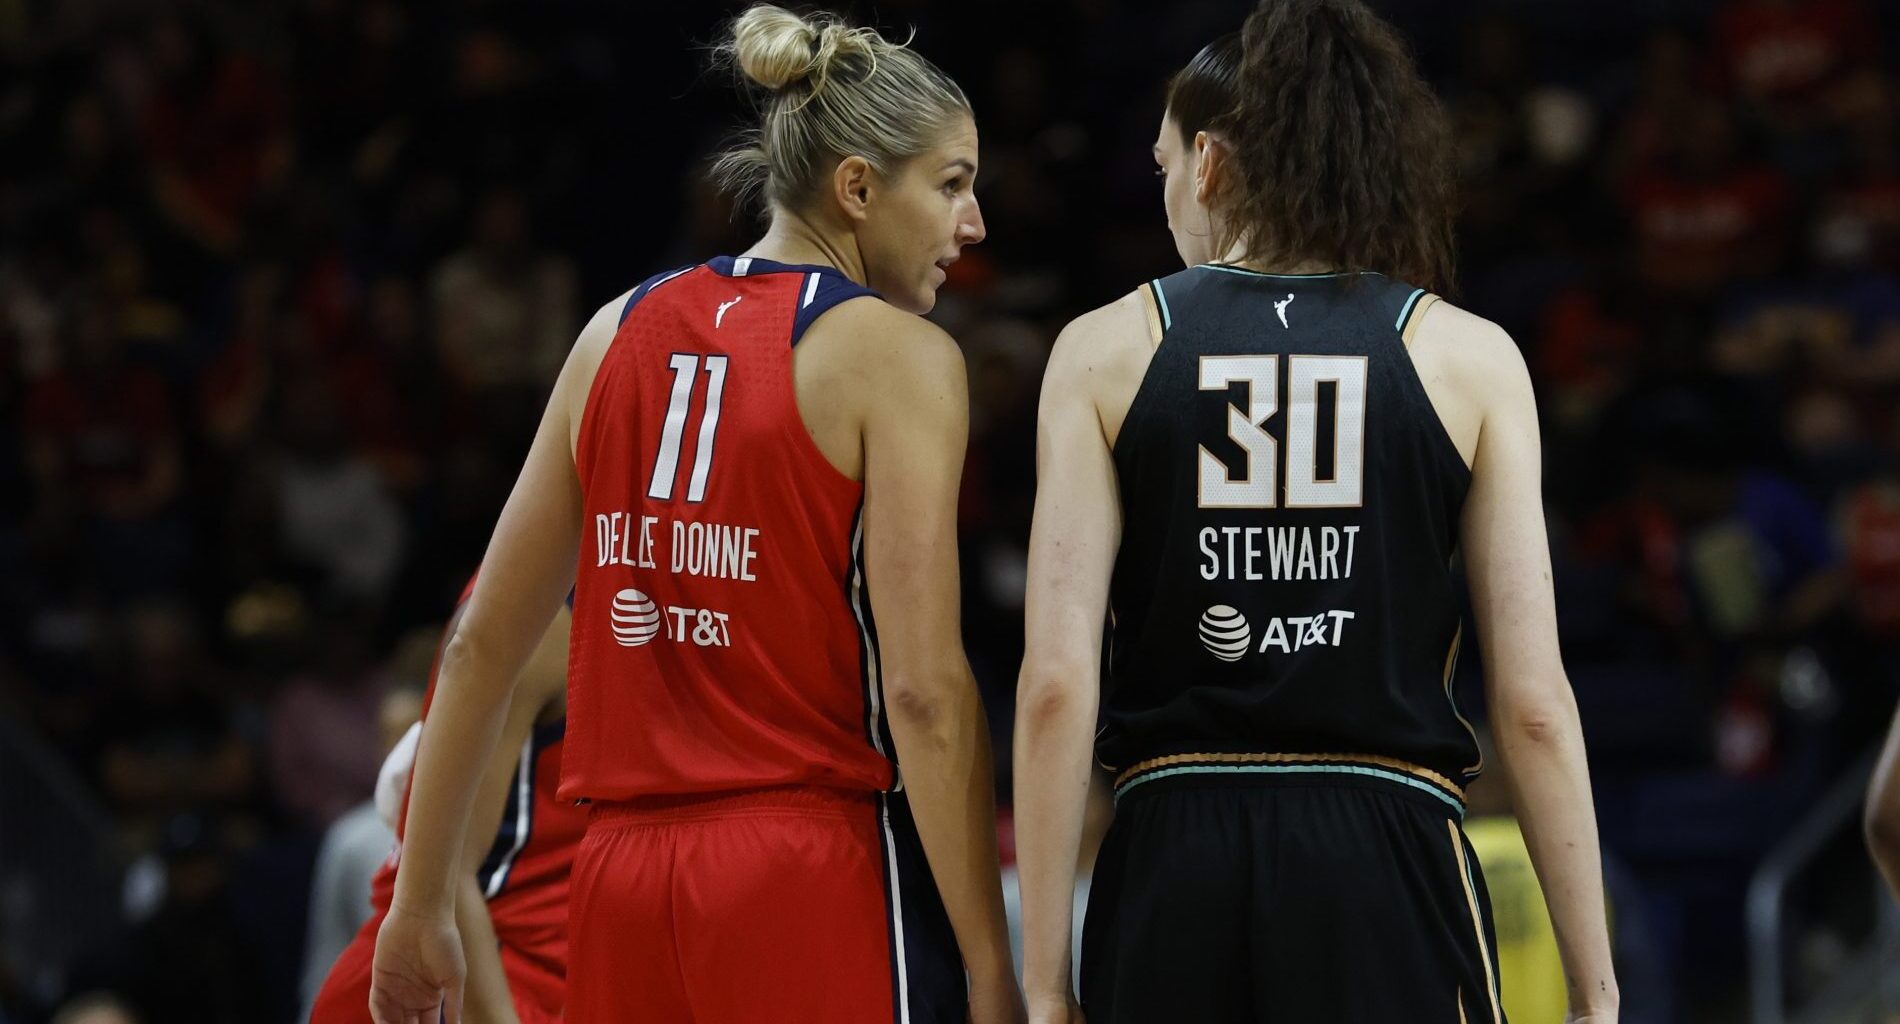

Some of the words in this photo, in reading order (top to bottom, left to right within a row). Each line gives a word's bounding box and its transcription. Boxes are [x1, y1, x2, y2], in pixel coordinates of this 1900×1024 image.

[646, 352, 729, 503] 11
[1198, 354, 1369, 508] 30
[596, 512, 659, 569] DELLE
[671, 520, 760, 582] DONNE
[1199, 525, 1360, 581] STEWART
[662, 605, 731, 647] T&T
[1258, 609, 1355, 654] AT&T
